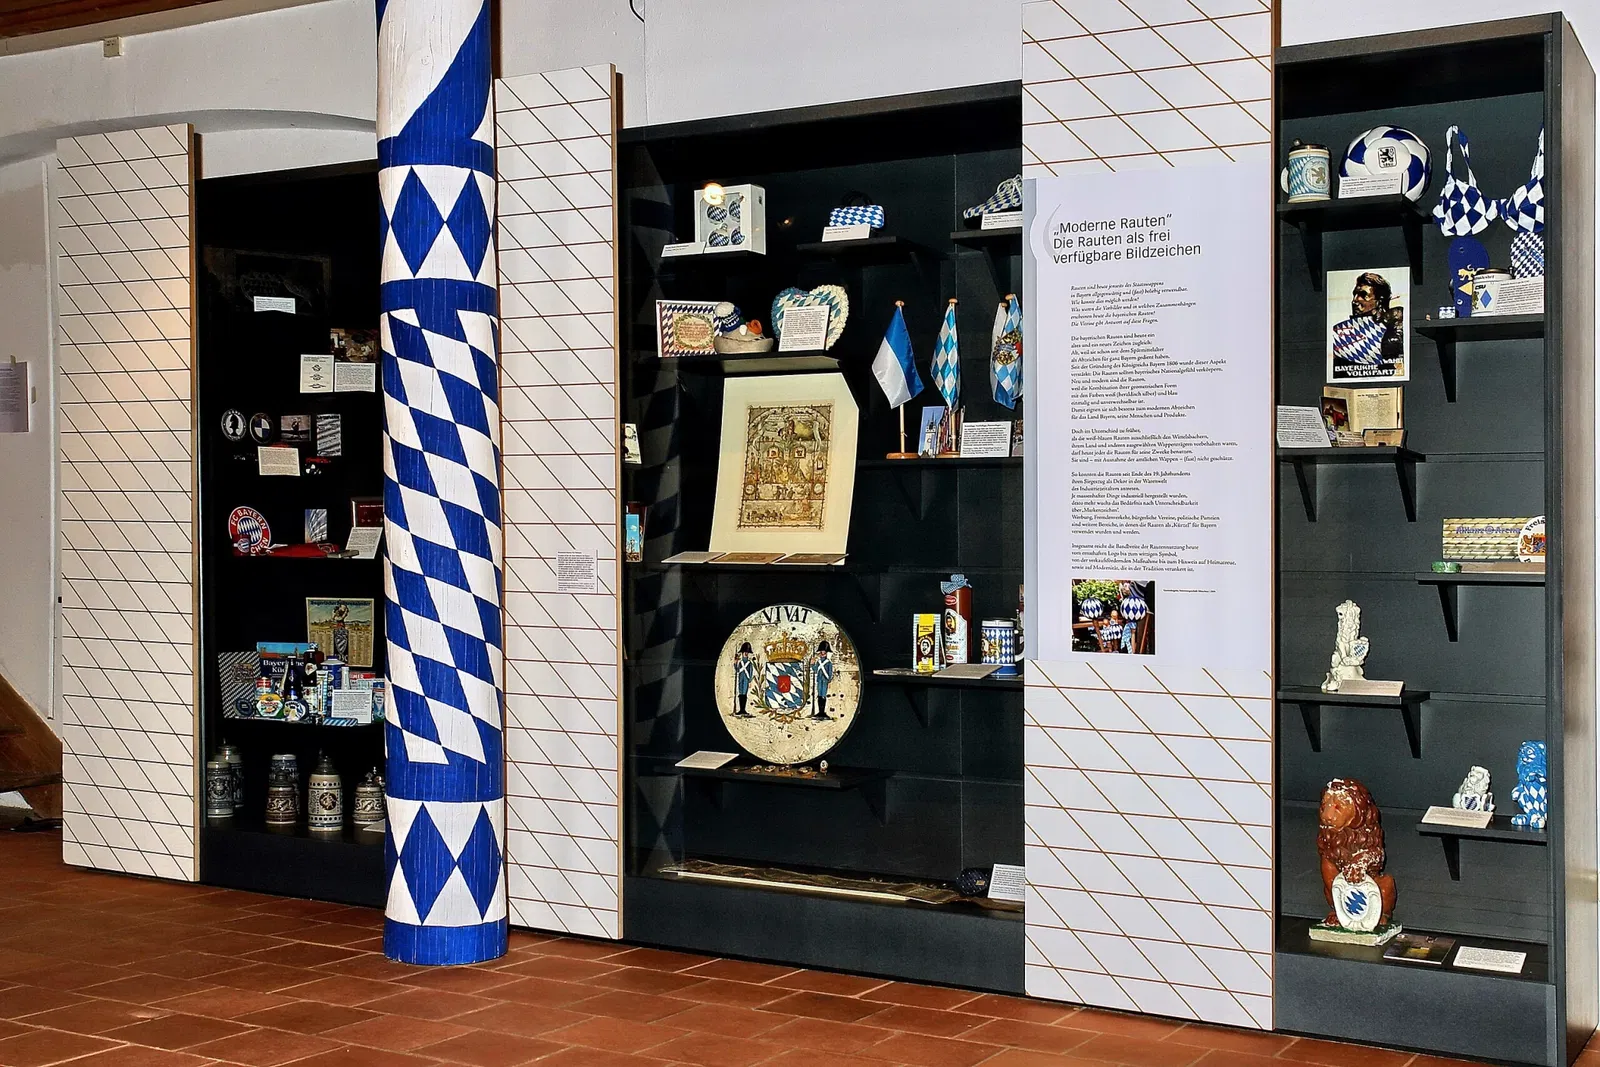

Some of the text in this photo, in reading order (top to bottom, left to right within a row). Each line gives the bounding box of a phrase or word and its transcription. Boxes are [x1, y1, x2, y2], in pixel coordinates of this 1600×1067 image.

[1054, 220, 1116, 235] „Moderne
[1053, 229, 1170, 249] Die Rauten als frei
[1053, 244, 1201, 265] verfügbare Bildzeichen
[230, 508, 268, 530] FC BAYERN
[761, 605, 813, 624] VIVAT
